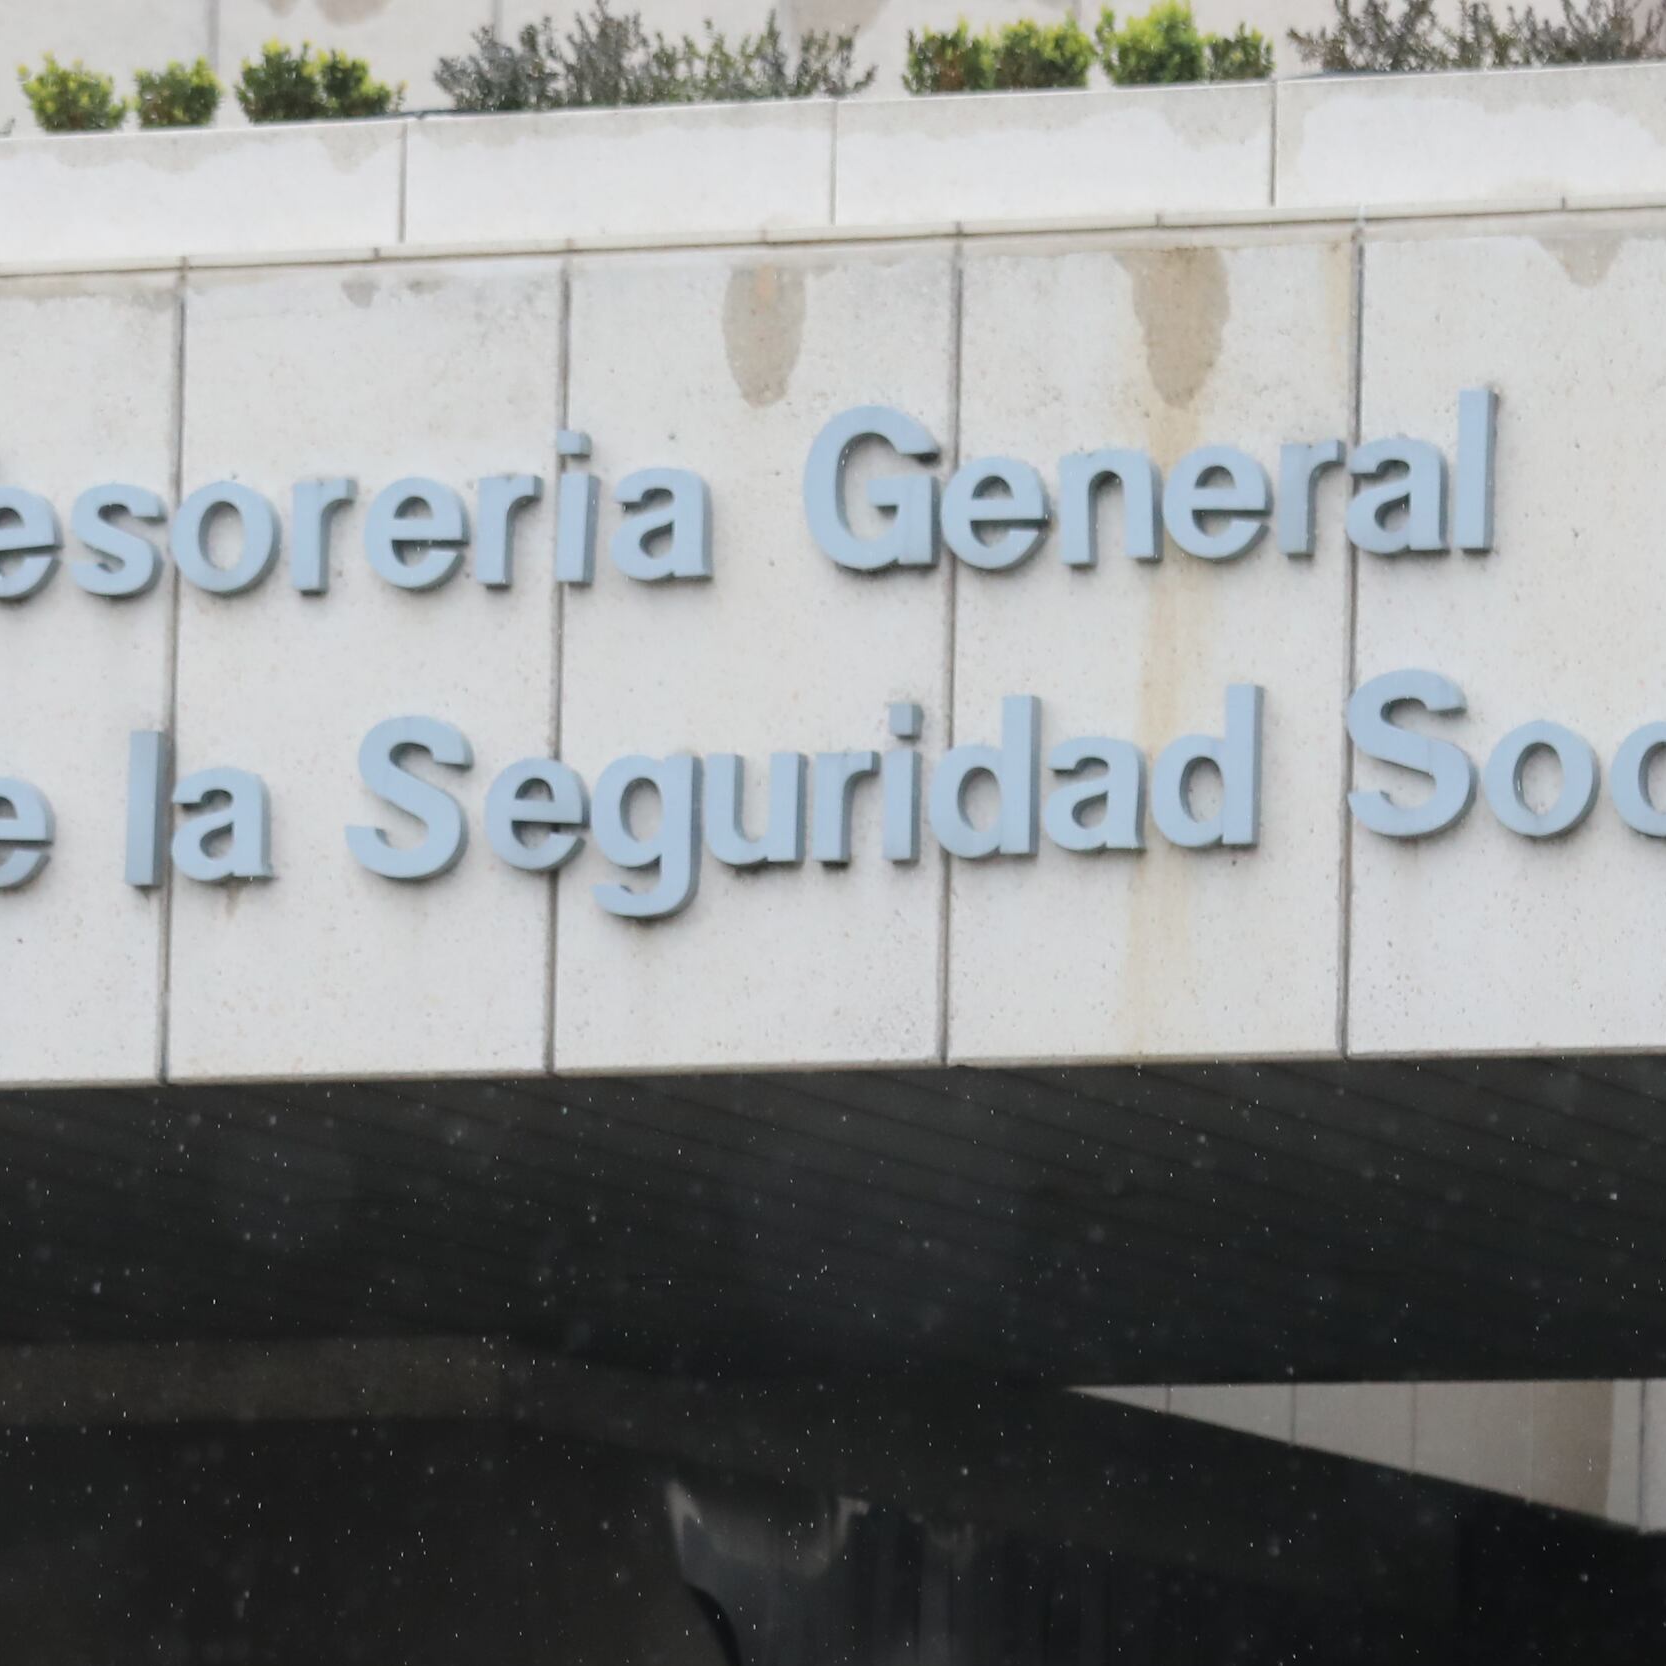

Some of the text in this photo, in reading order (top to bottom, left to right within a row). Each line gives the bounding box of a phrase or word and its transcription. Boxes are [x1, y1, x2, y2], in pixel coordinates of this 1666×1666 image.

[804, 388, 1493, 571] General
[126, 728, 269, 888] la
[346, 683, 1259, 918] Seguridad
